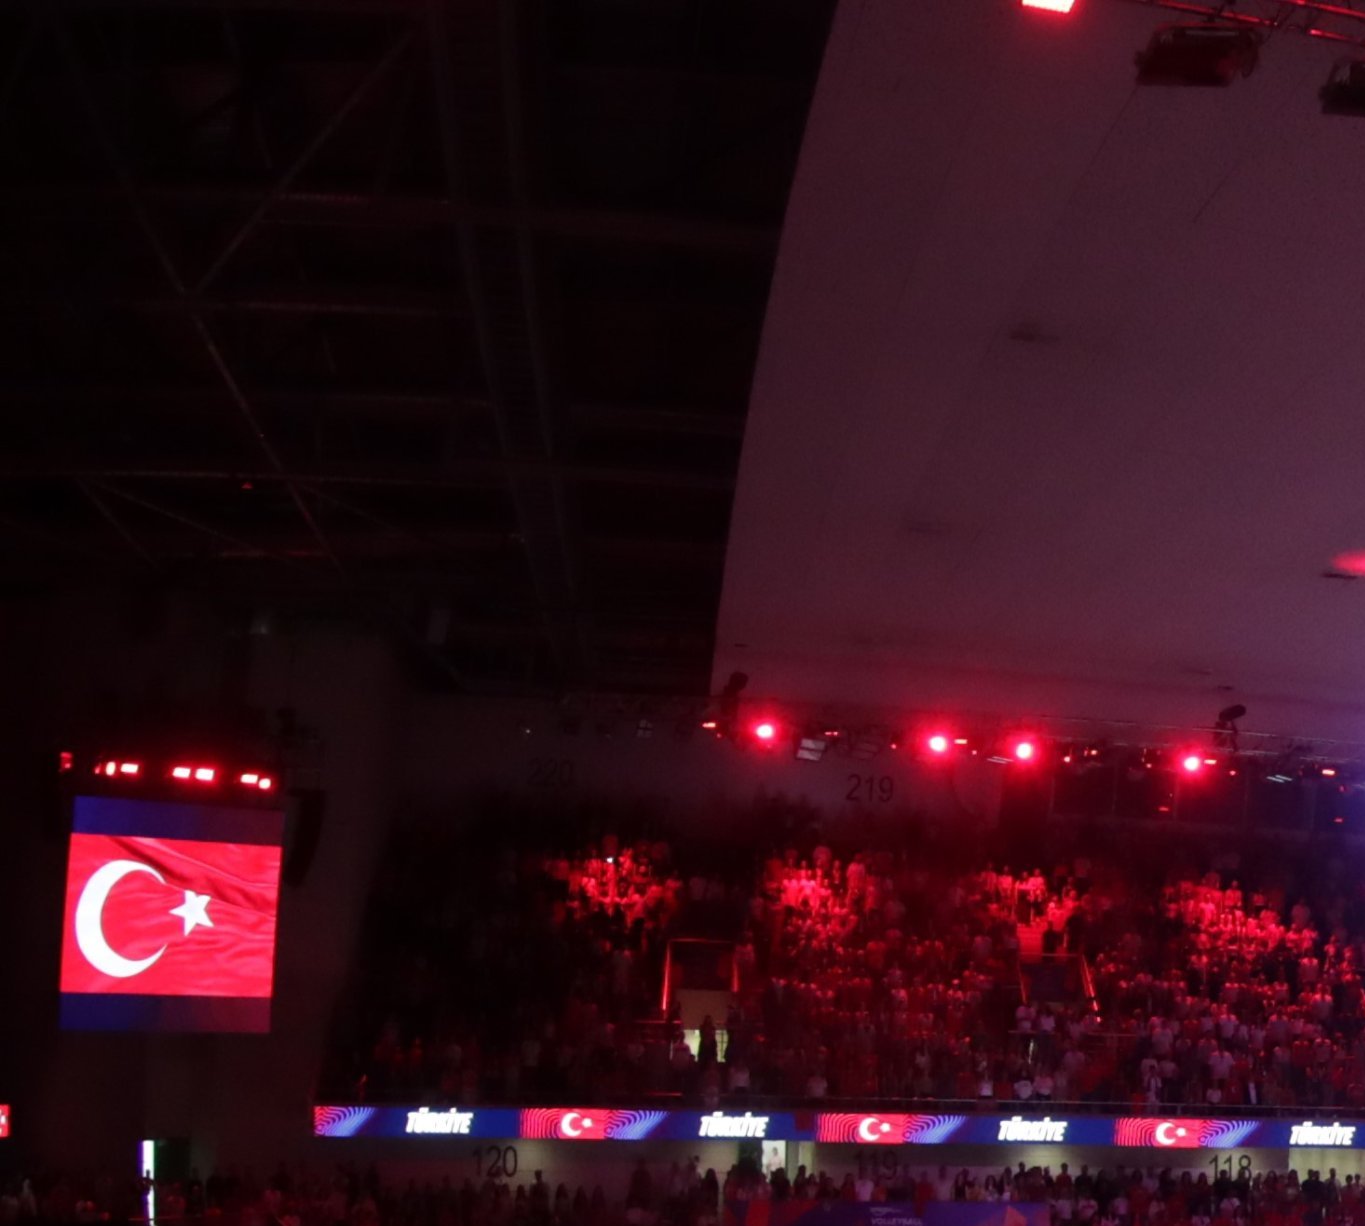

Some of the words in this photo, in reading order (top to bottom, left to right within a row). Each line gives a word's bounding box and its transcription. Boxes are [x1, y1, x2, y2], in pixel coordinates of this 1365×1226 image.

[846, 773, 895, 802] 219
[406, 1107, 473, 1133] TÜRKİYE
[699, 1111, 769, 1137] TÜRKİYE
[998, 1116, 1067, 1141] TÜRKİYE
[1290, 1122, 1355, 1145] TÜRKİYE
[473, 1146, 518, 1177] 120
[857, 1150, 899, 1181] 119
[1209, 1155, 1252, 1182] 118
